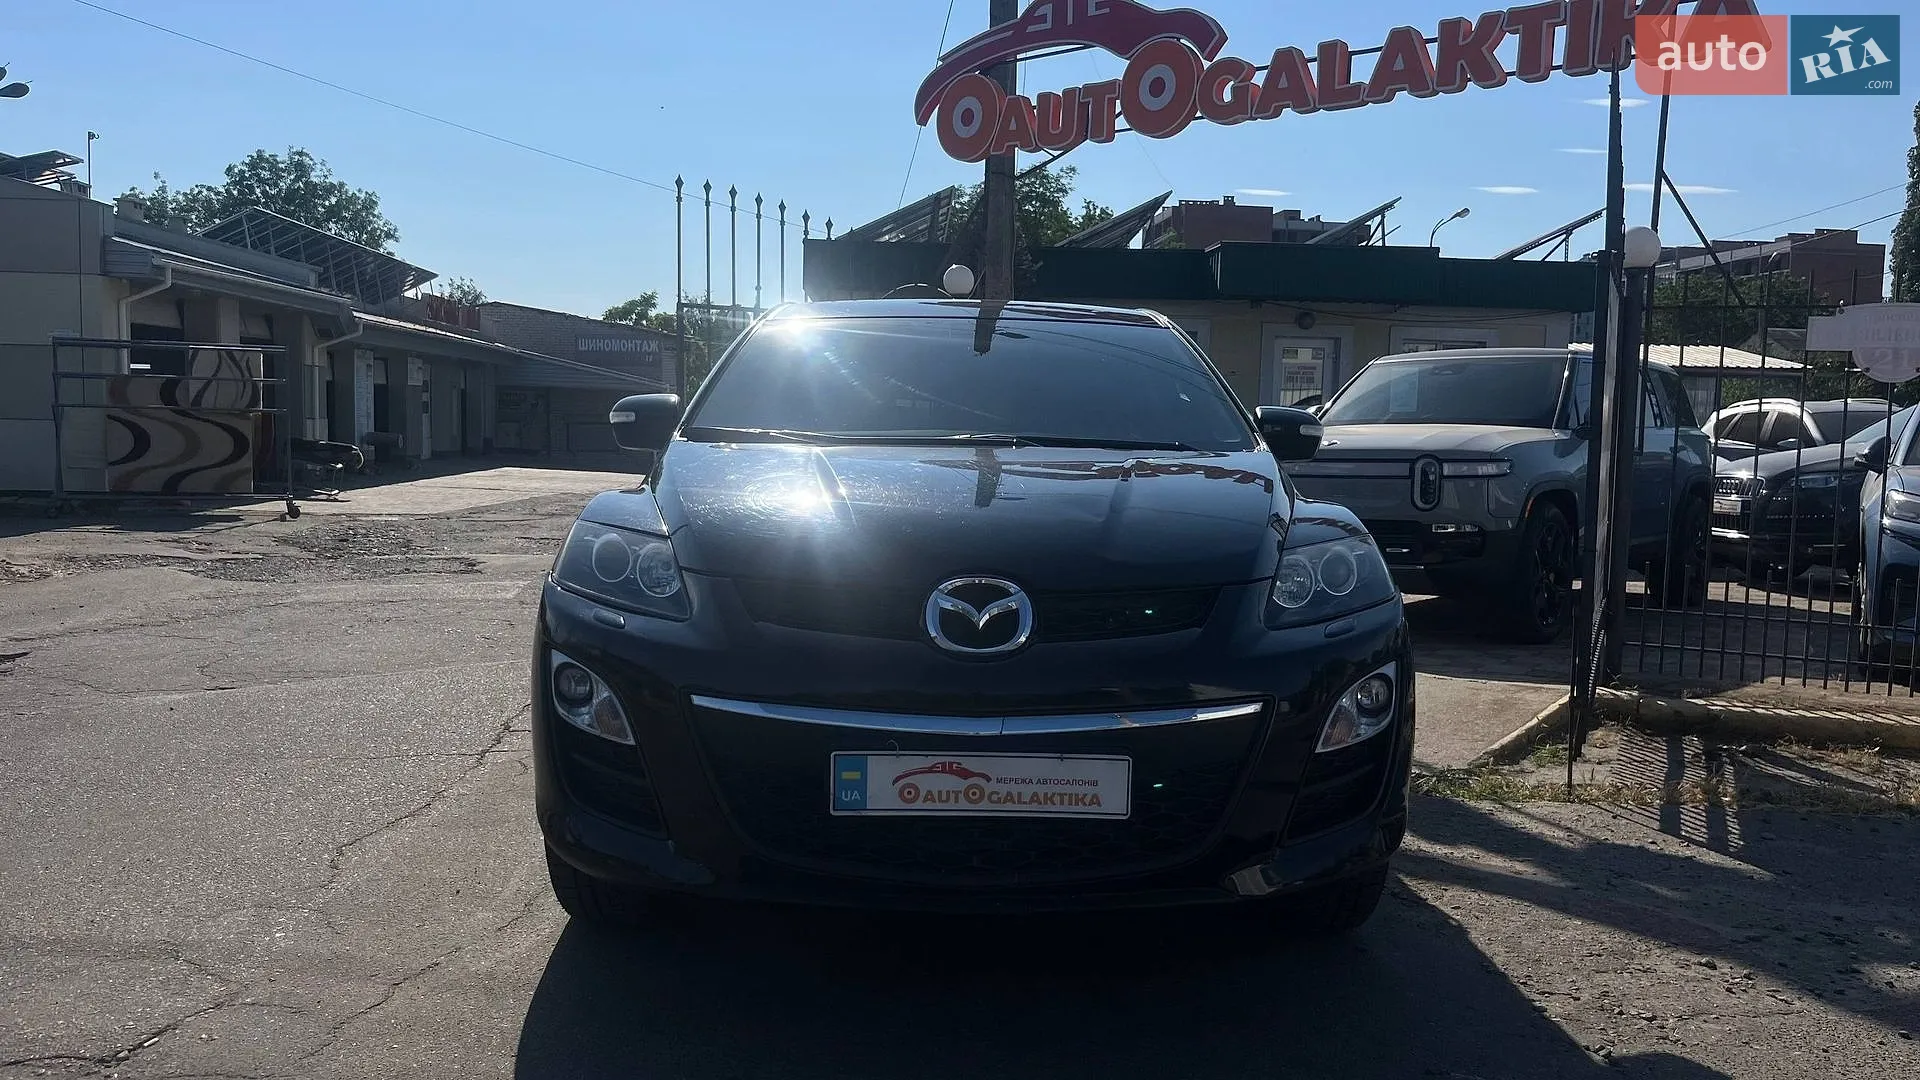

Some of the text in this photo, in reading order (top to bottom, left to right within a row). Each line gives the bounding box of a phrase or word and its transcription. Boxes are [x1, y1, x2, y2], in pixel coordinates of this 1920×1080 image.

[578, 338, 660, 353] ШИНОМОНТАЖ
[995, 776, 1099, 788] МЕРЕЖА АВТОСАЛОНІВ
[841, 790, 861, 802] UA
